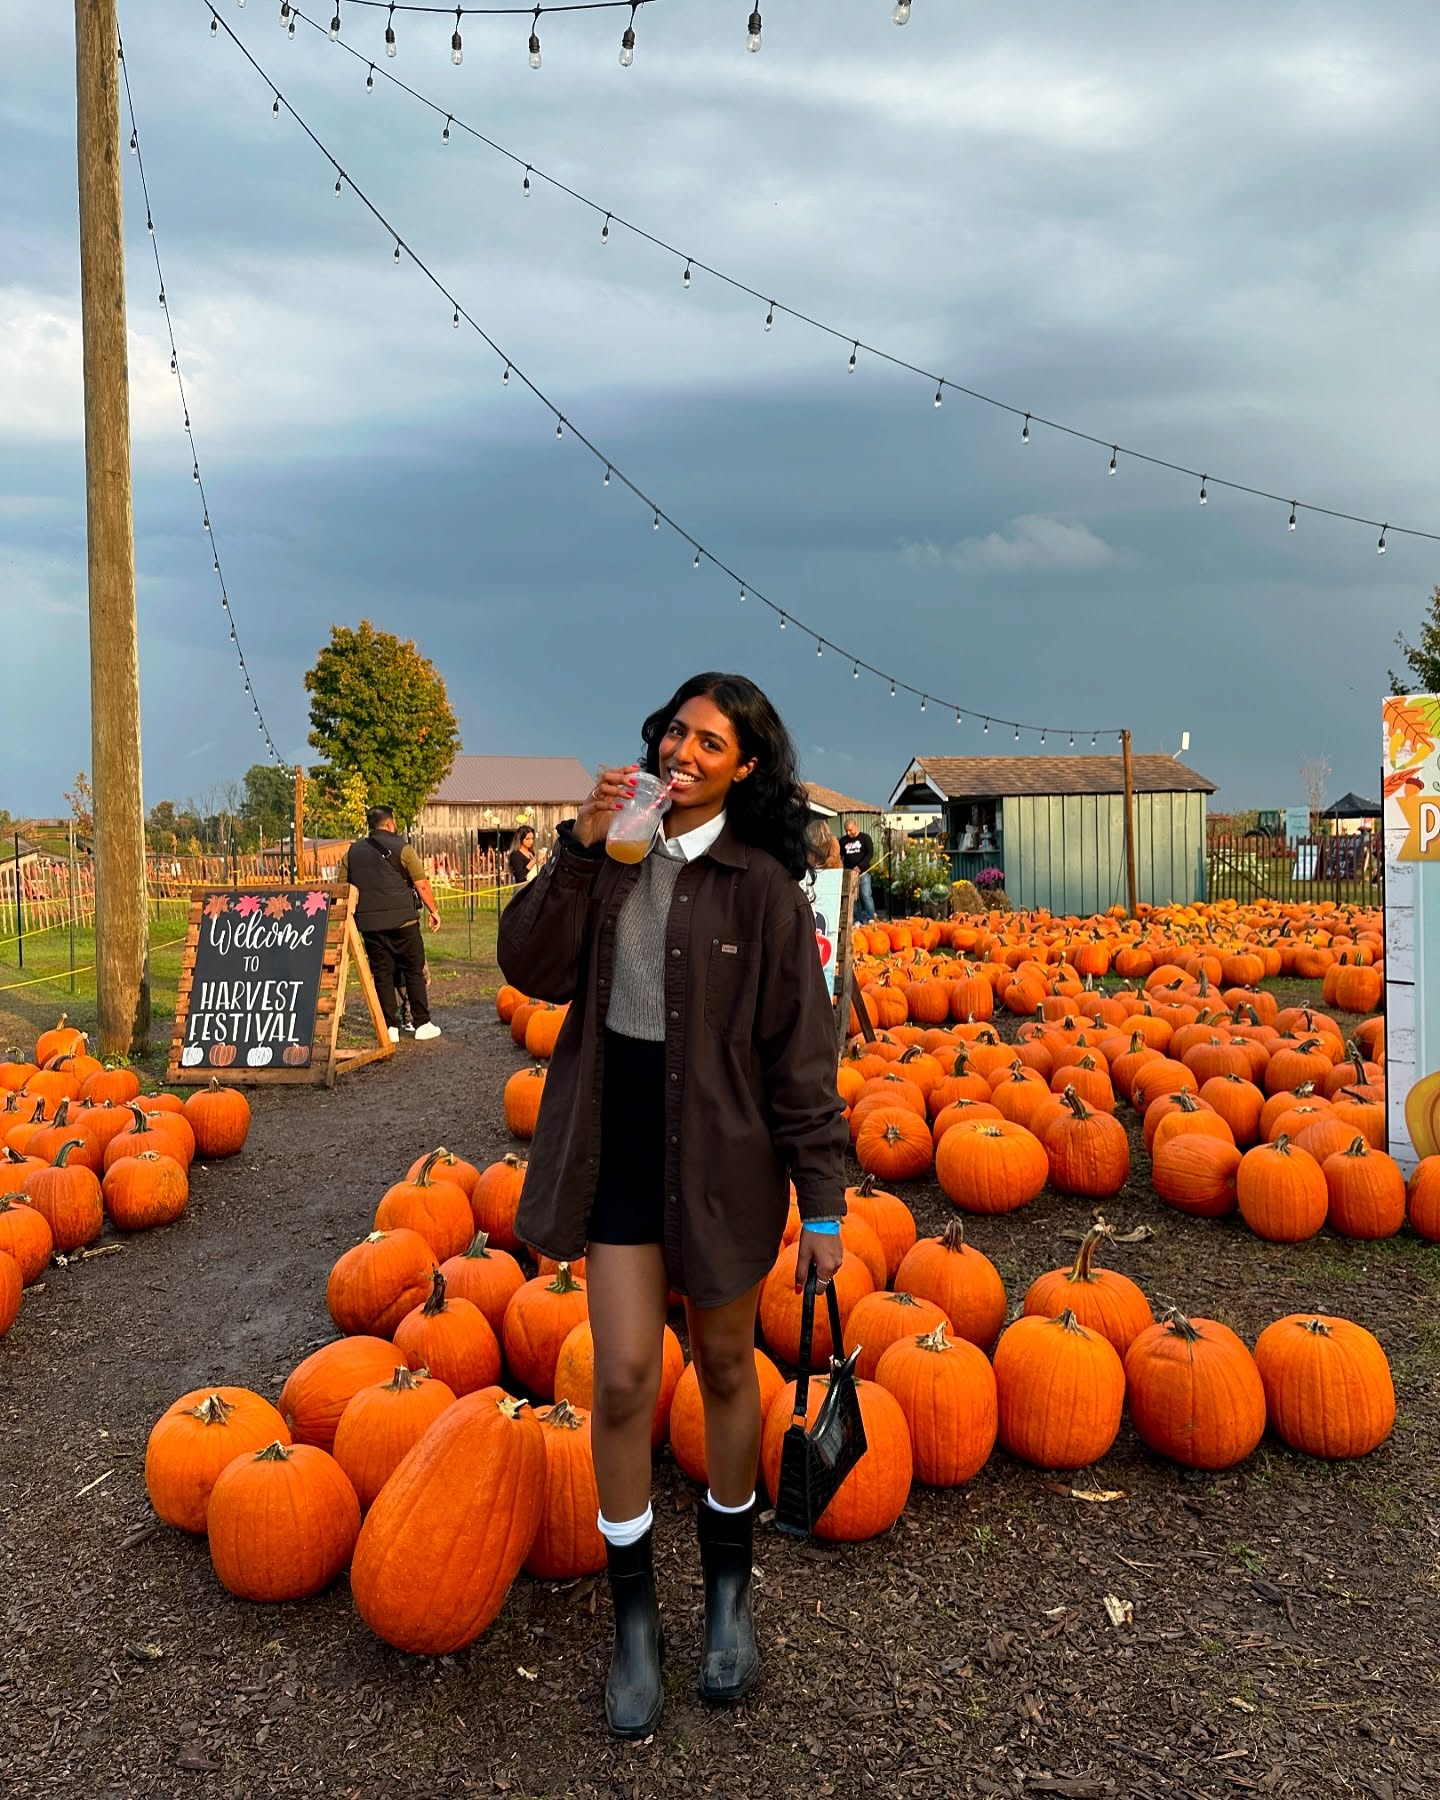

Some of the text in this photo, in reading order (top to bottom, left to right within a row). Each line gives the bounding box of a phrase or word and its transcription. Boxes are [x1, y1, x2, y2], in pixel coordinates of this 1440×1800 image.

[210, 910, 316, 955] Welcome
[243, 956, 259, 972] TO
[200, 980, 303, 1011] HARVEST
[188, 1012, 299, 1042] FESTIVAL
